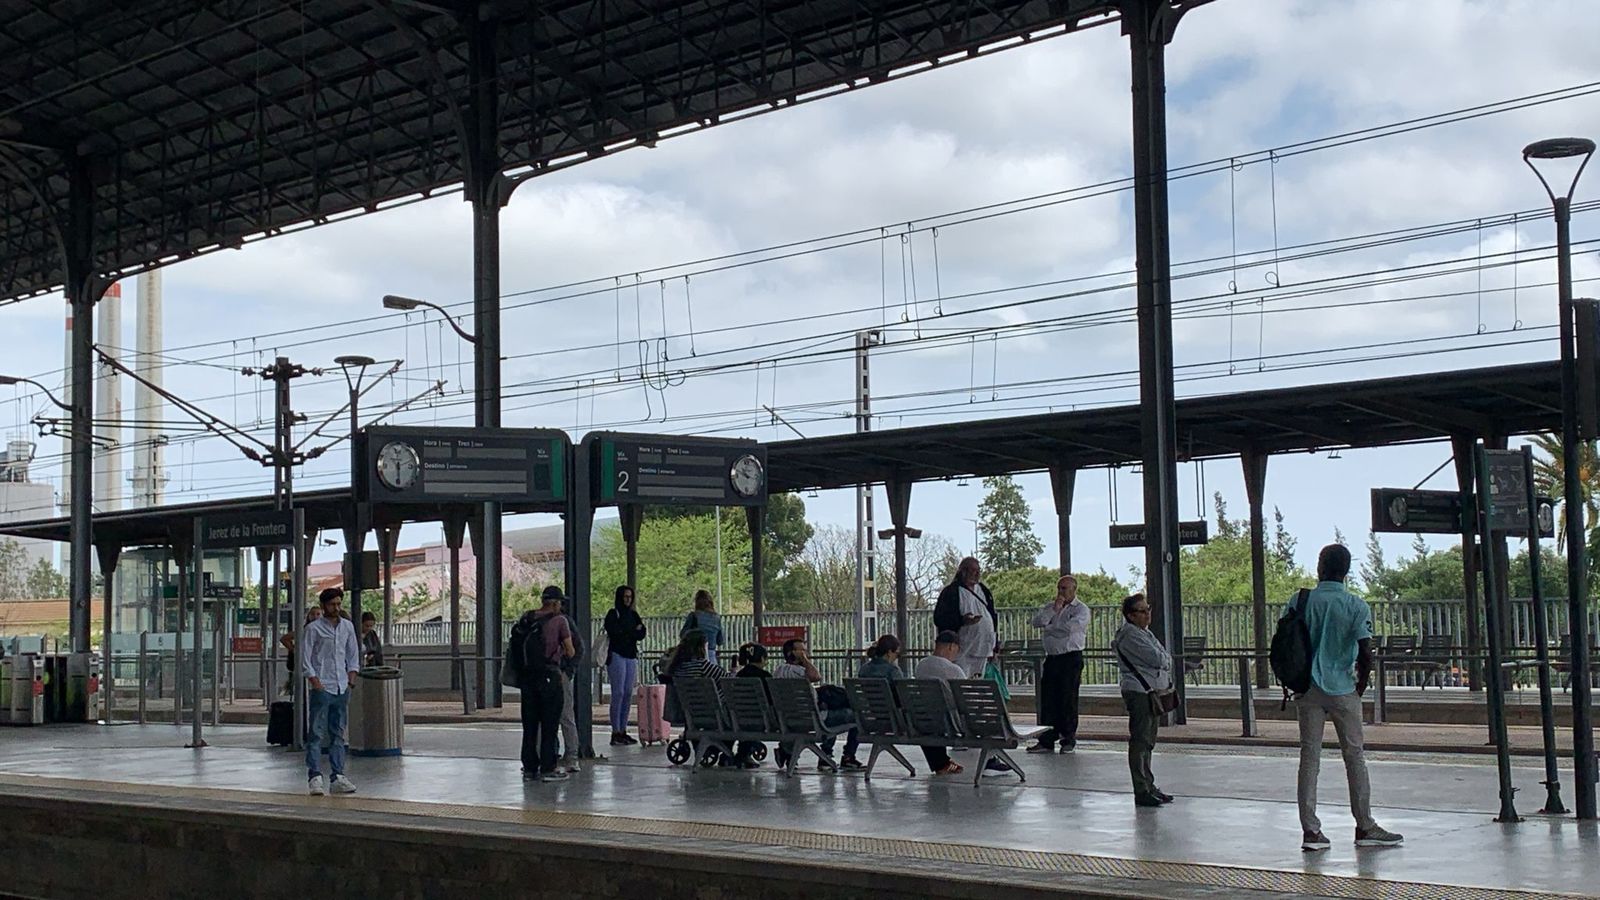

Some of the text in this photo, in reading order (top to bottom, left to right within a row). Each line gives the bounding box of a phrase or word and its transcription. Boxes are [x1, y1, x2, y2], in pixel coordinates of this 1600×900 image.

[618, 471, 629, 492] 2
[208, 522, 286, 540] Jerez de la Frontera
[1118, 532, 1138, 542] Jerez
[1140, 532, 1146, 540] d
